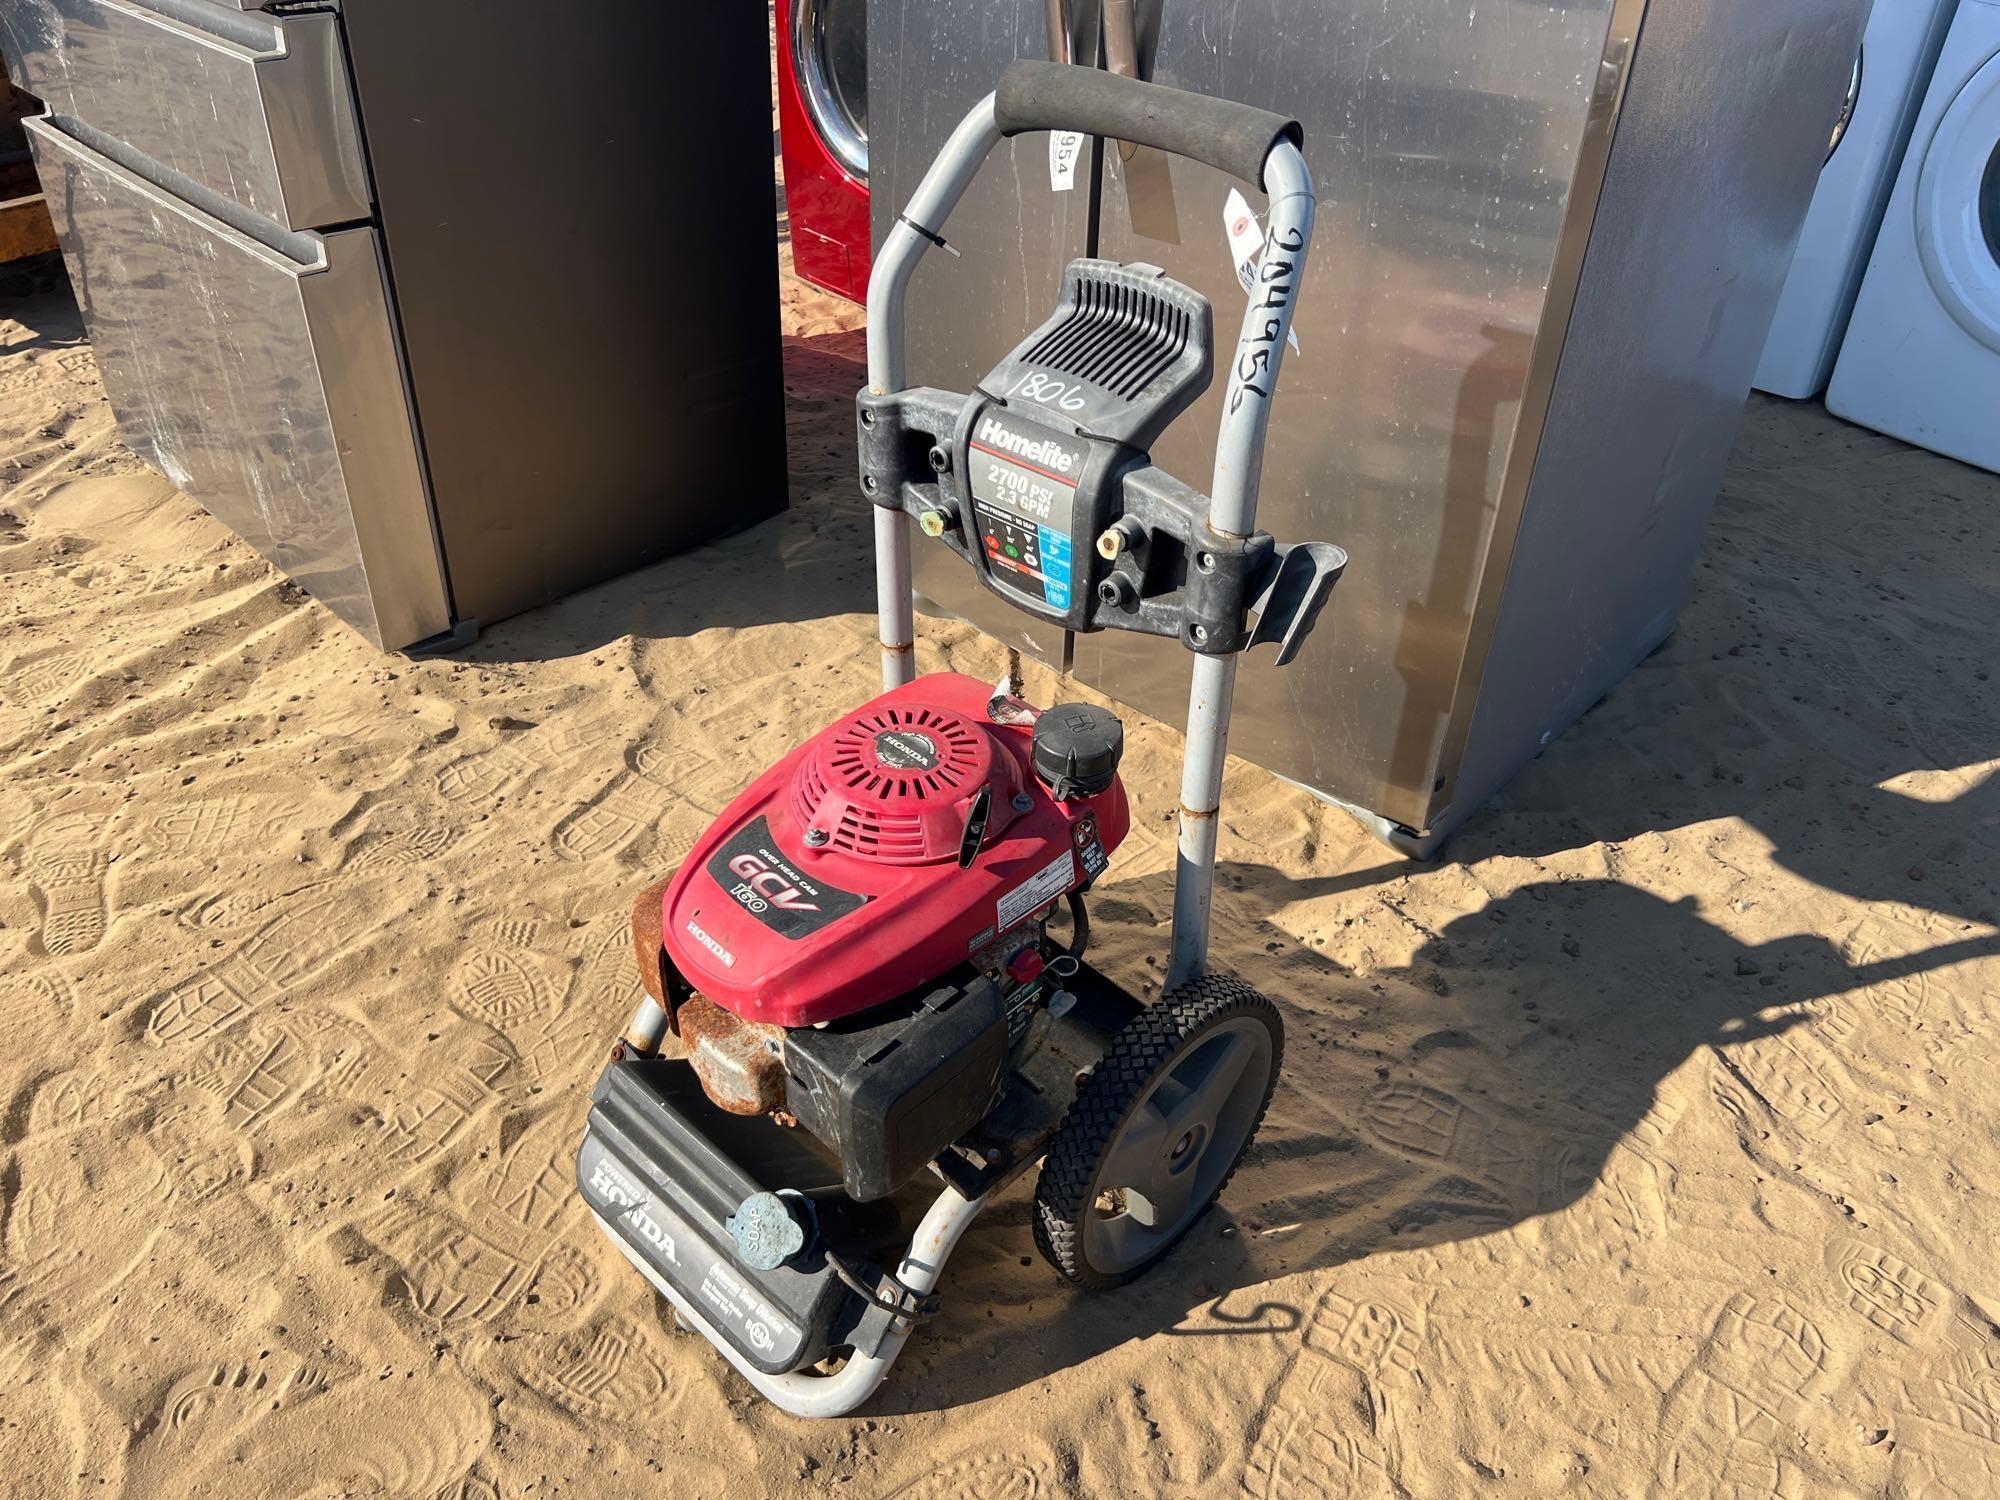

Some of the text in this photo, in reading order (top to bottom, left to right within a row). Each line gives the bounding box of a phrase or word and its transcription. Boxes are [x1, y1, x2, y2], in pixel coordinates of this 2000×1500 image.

[1006, 370, 1085, 411] 1806
[980, 418, 1073, 472] Homelite
[988, 464, 1054, 506] 2700 PSI
[996, 486, 1052, 519] 2.3 GPM
[884, 735, 929, 767] HONDA
[728, 854, 822, 912] GCV
[758, 849, 819, 896] OVER HEAD CAM
[730, 883, 768, 913] 160
[686, 921, 735, 968] HONDA
[599, 1158, 641, 1200] POWERED
[590, 1166, 677, 1264] HONDA
[747, 1208, 761, 1252] SOAP
[739, 1288, 758, 1312] Soap
